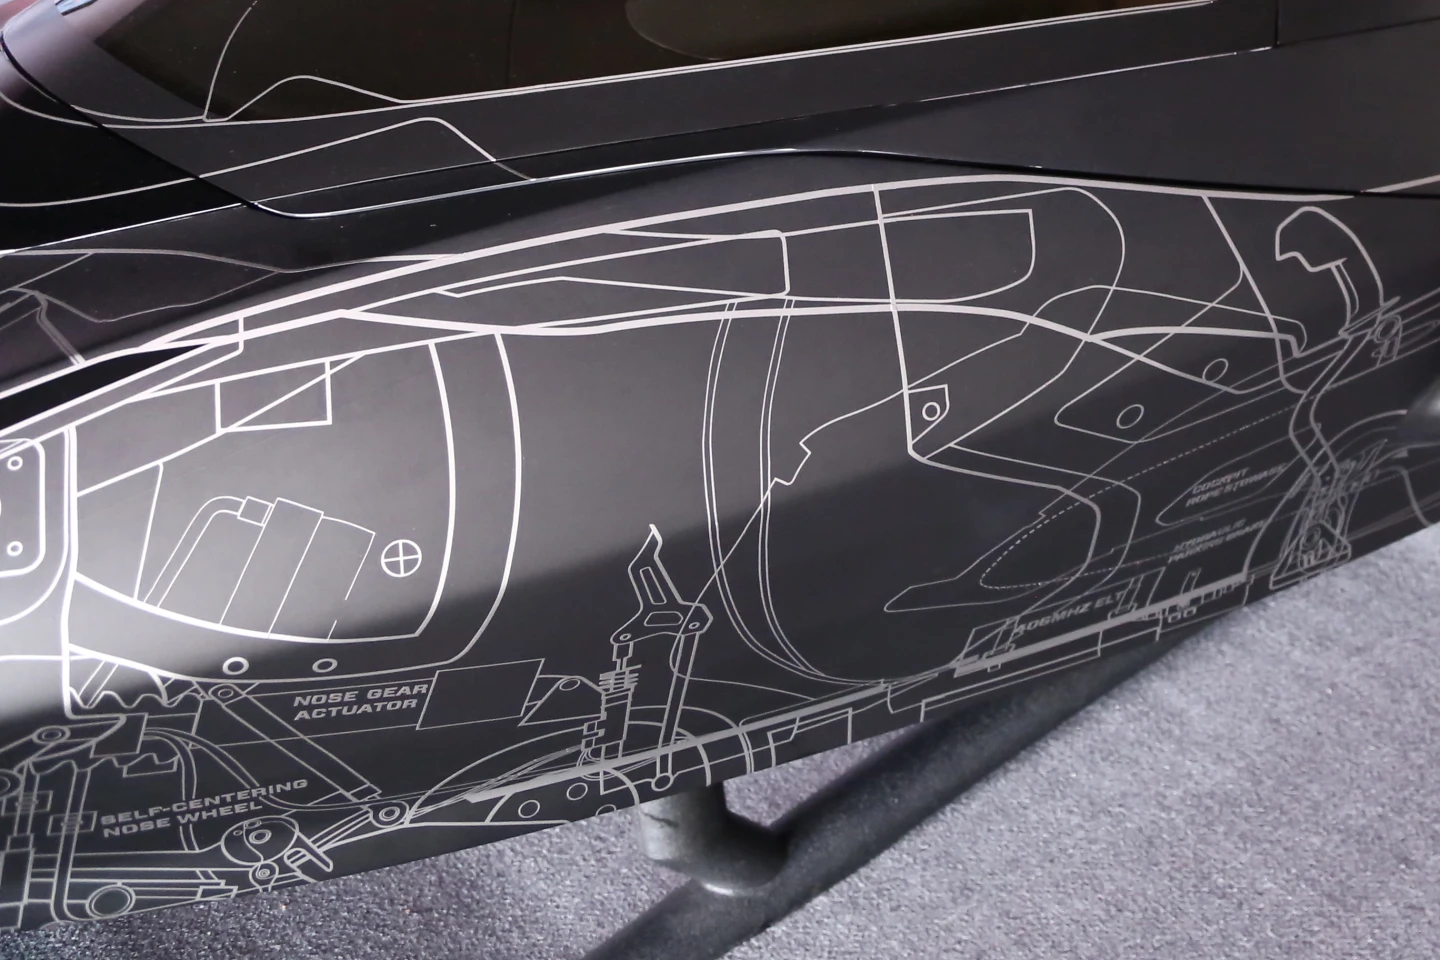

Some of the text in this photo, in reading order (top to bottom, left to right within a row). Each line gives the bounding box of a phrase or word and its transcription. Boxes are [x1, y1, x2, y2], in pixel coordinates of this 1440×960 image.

[1192, 467, 1250, 495] COCKPIT
[293, 684, 429, 707] NOSE GEAR
[294, 699, 418, 721] ACTUATOR
[101, 779, 308, 825] SELF-CENTERING
[104, 801, 263, 838] NOSE WHEEL
